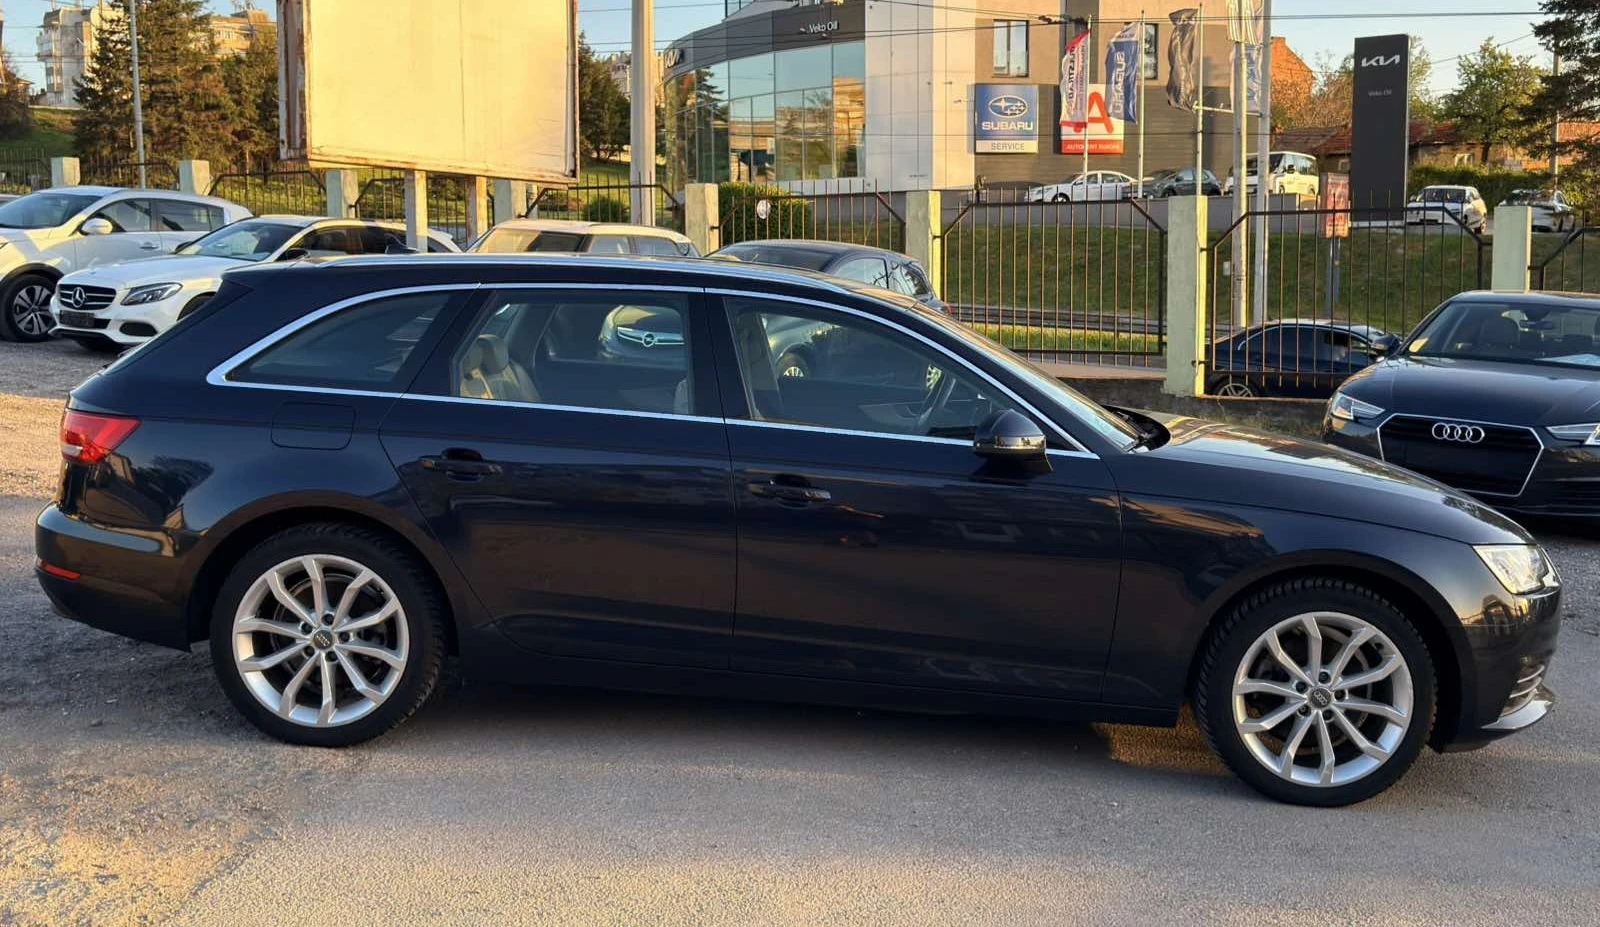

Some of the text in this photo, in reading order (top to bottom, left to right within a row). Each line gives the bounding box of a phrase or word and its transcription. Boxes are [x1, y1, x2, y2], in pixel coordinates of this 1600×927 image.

[1361, 54, 1401, 67] KIA
[982, 121, 1034, 131] SUBARU
[991, 142, 1025, 151] SERVICE
